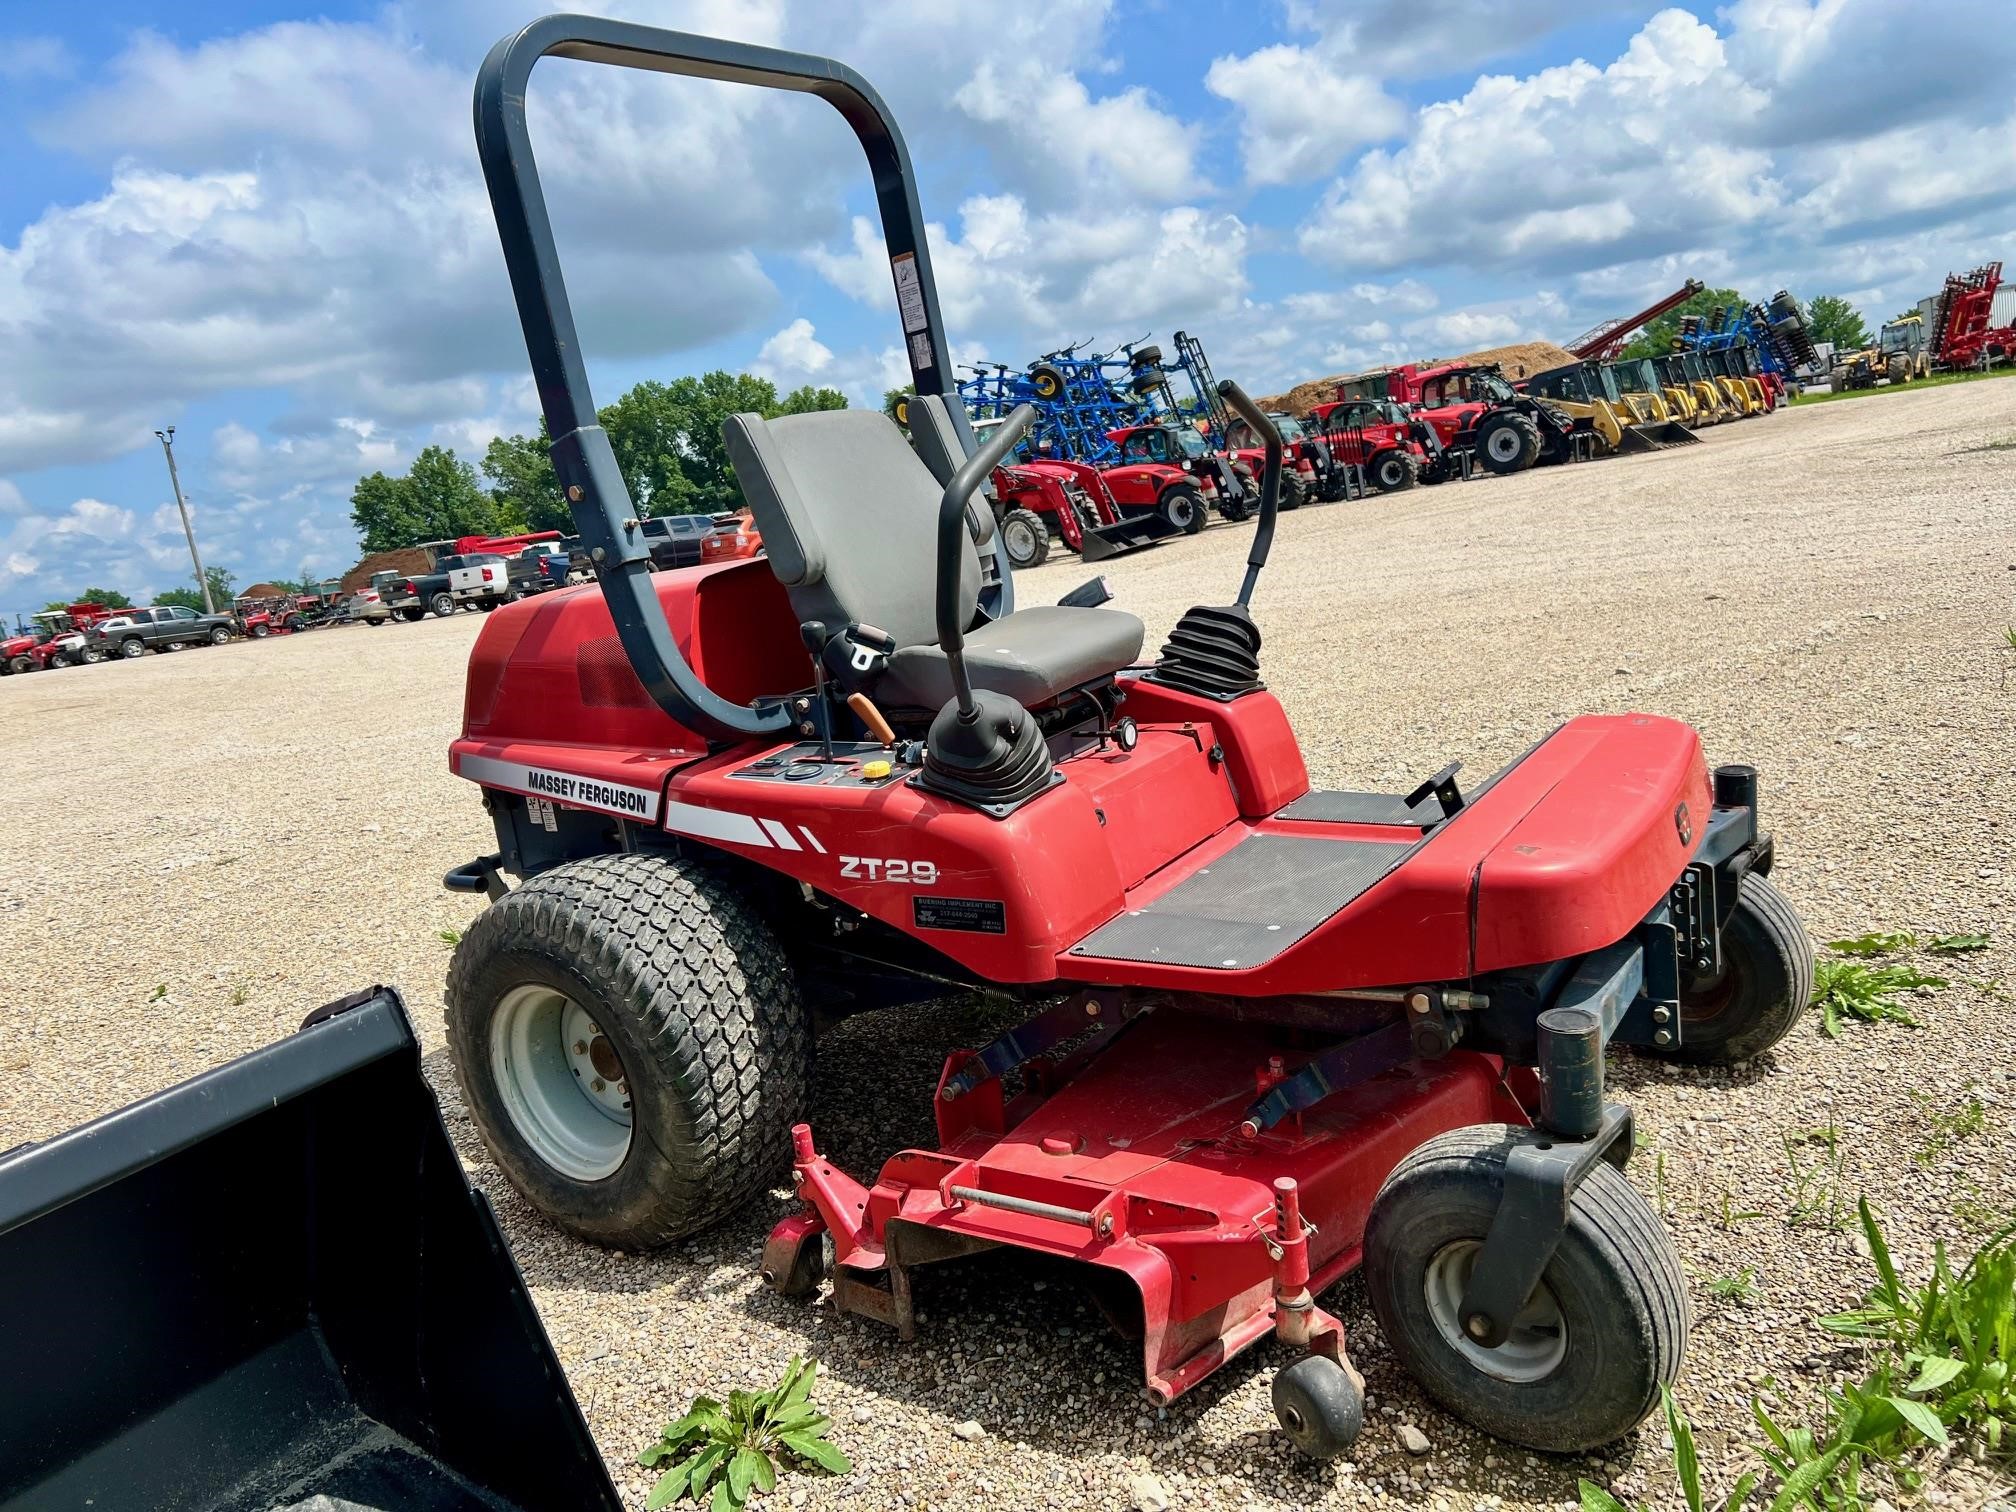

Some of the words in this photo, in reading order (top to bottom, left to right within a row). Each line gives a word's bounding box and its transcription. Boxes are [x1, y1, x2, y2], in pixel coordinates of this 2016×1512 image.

[528, 771, 576, 797] MASSEY
[578, 782, 647, 814] FERGUSON
[839, 856, 936, 884] ZT29
[947, 900, 983, 908] IMPLEMENT
